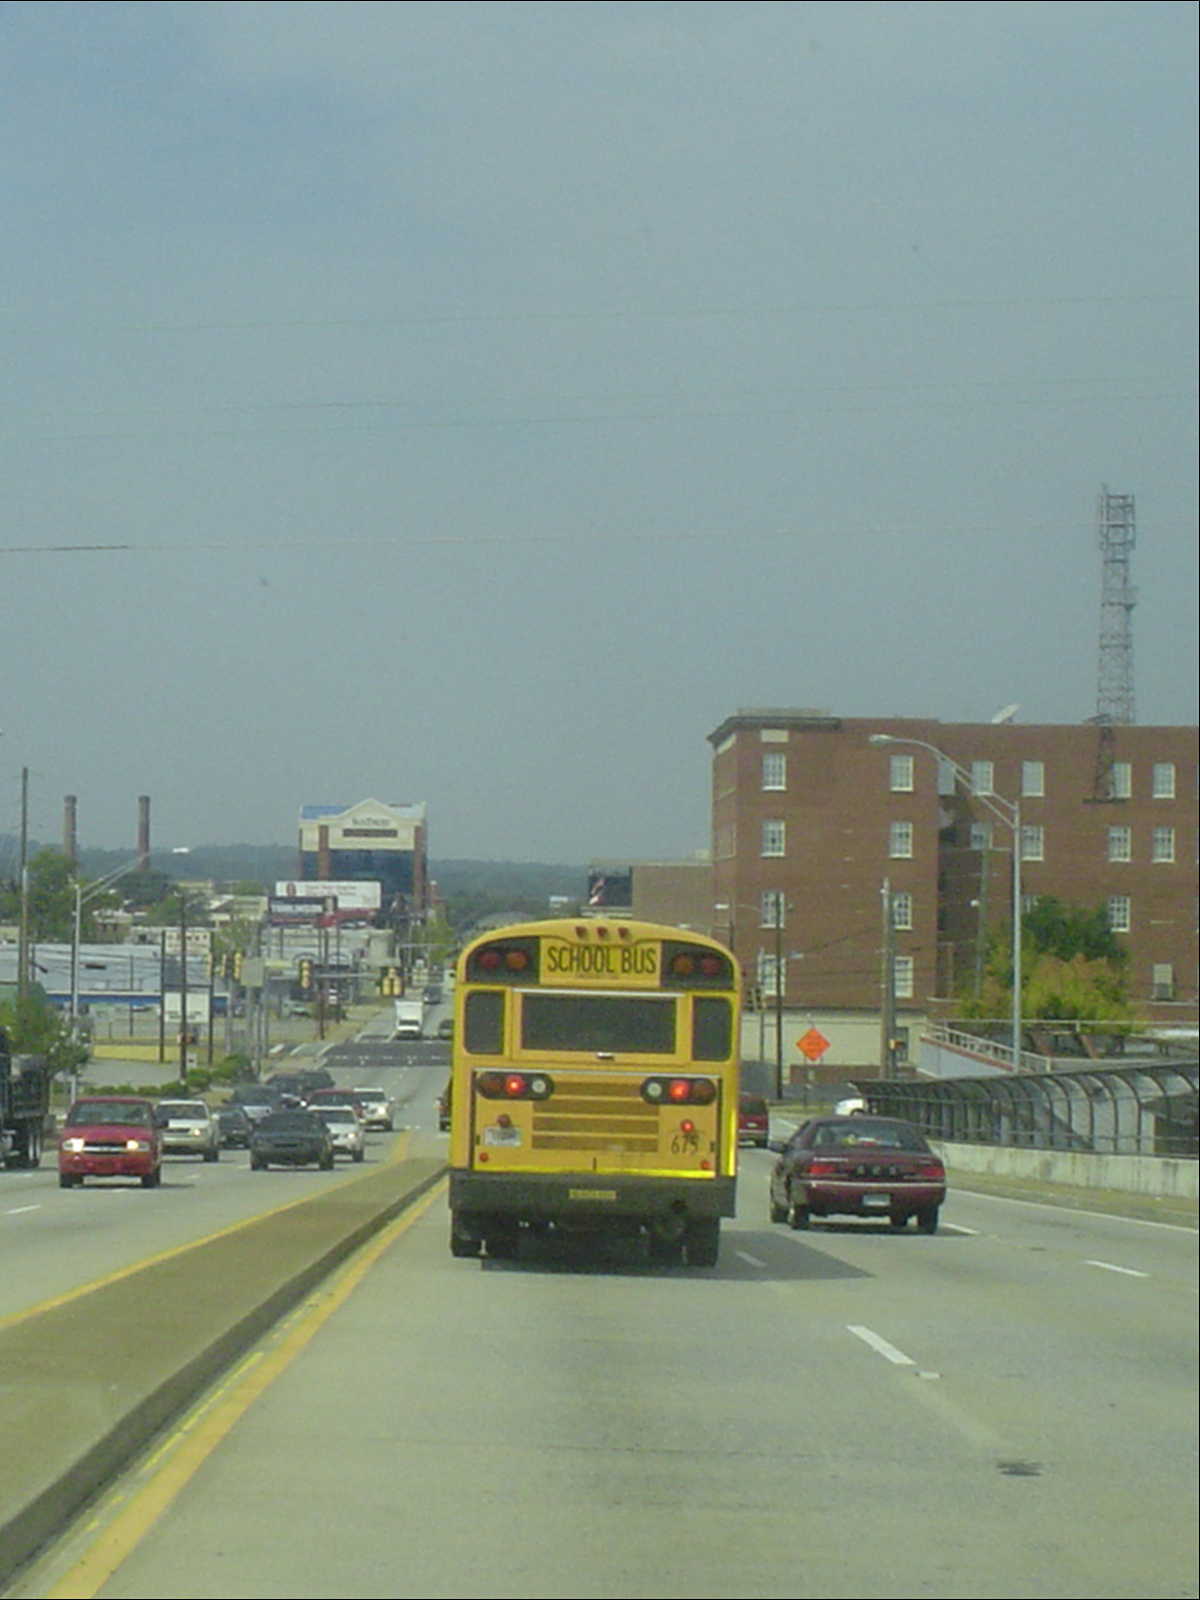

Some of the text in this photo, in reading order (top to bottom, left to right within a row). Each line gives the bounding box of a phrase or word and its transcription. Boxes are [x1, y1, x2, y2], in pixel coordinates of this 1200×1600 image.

[547, 945, 657, 974] SCHOOL BUS
[670, 1135, 699, 1155] 675
